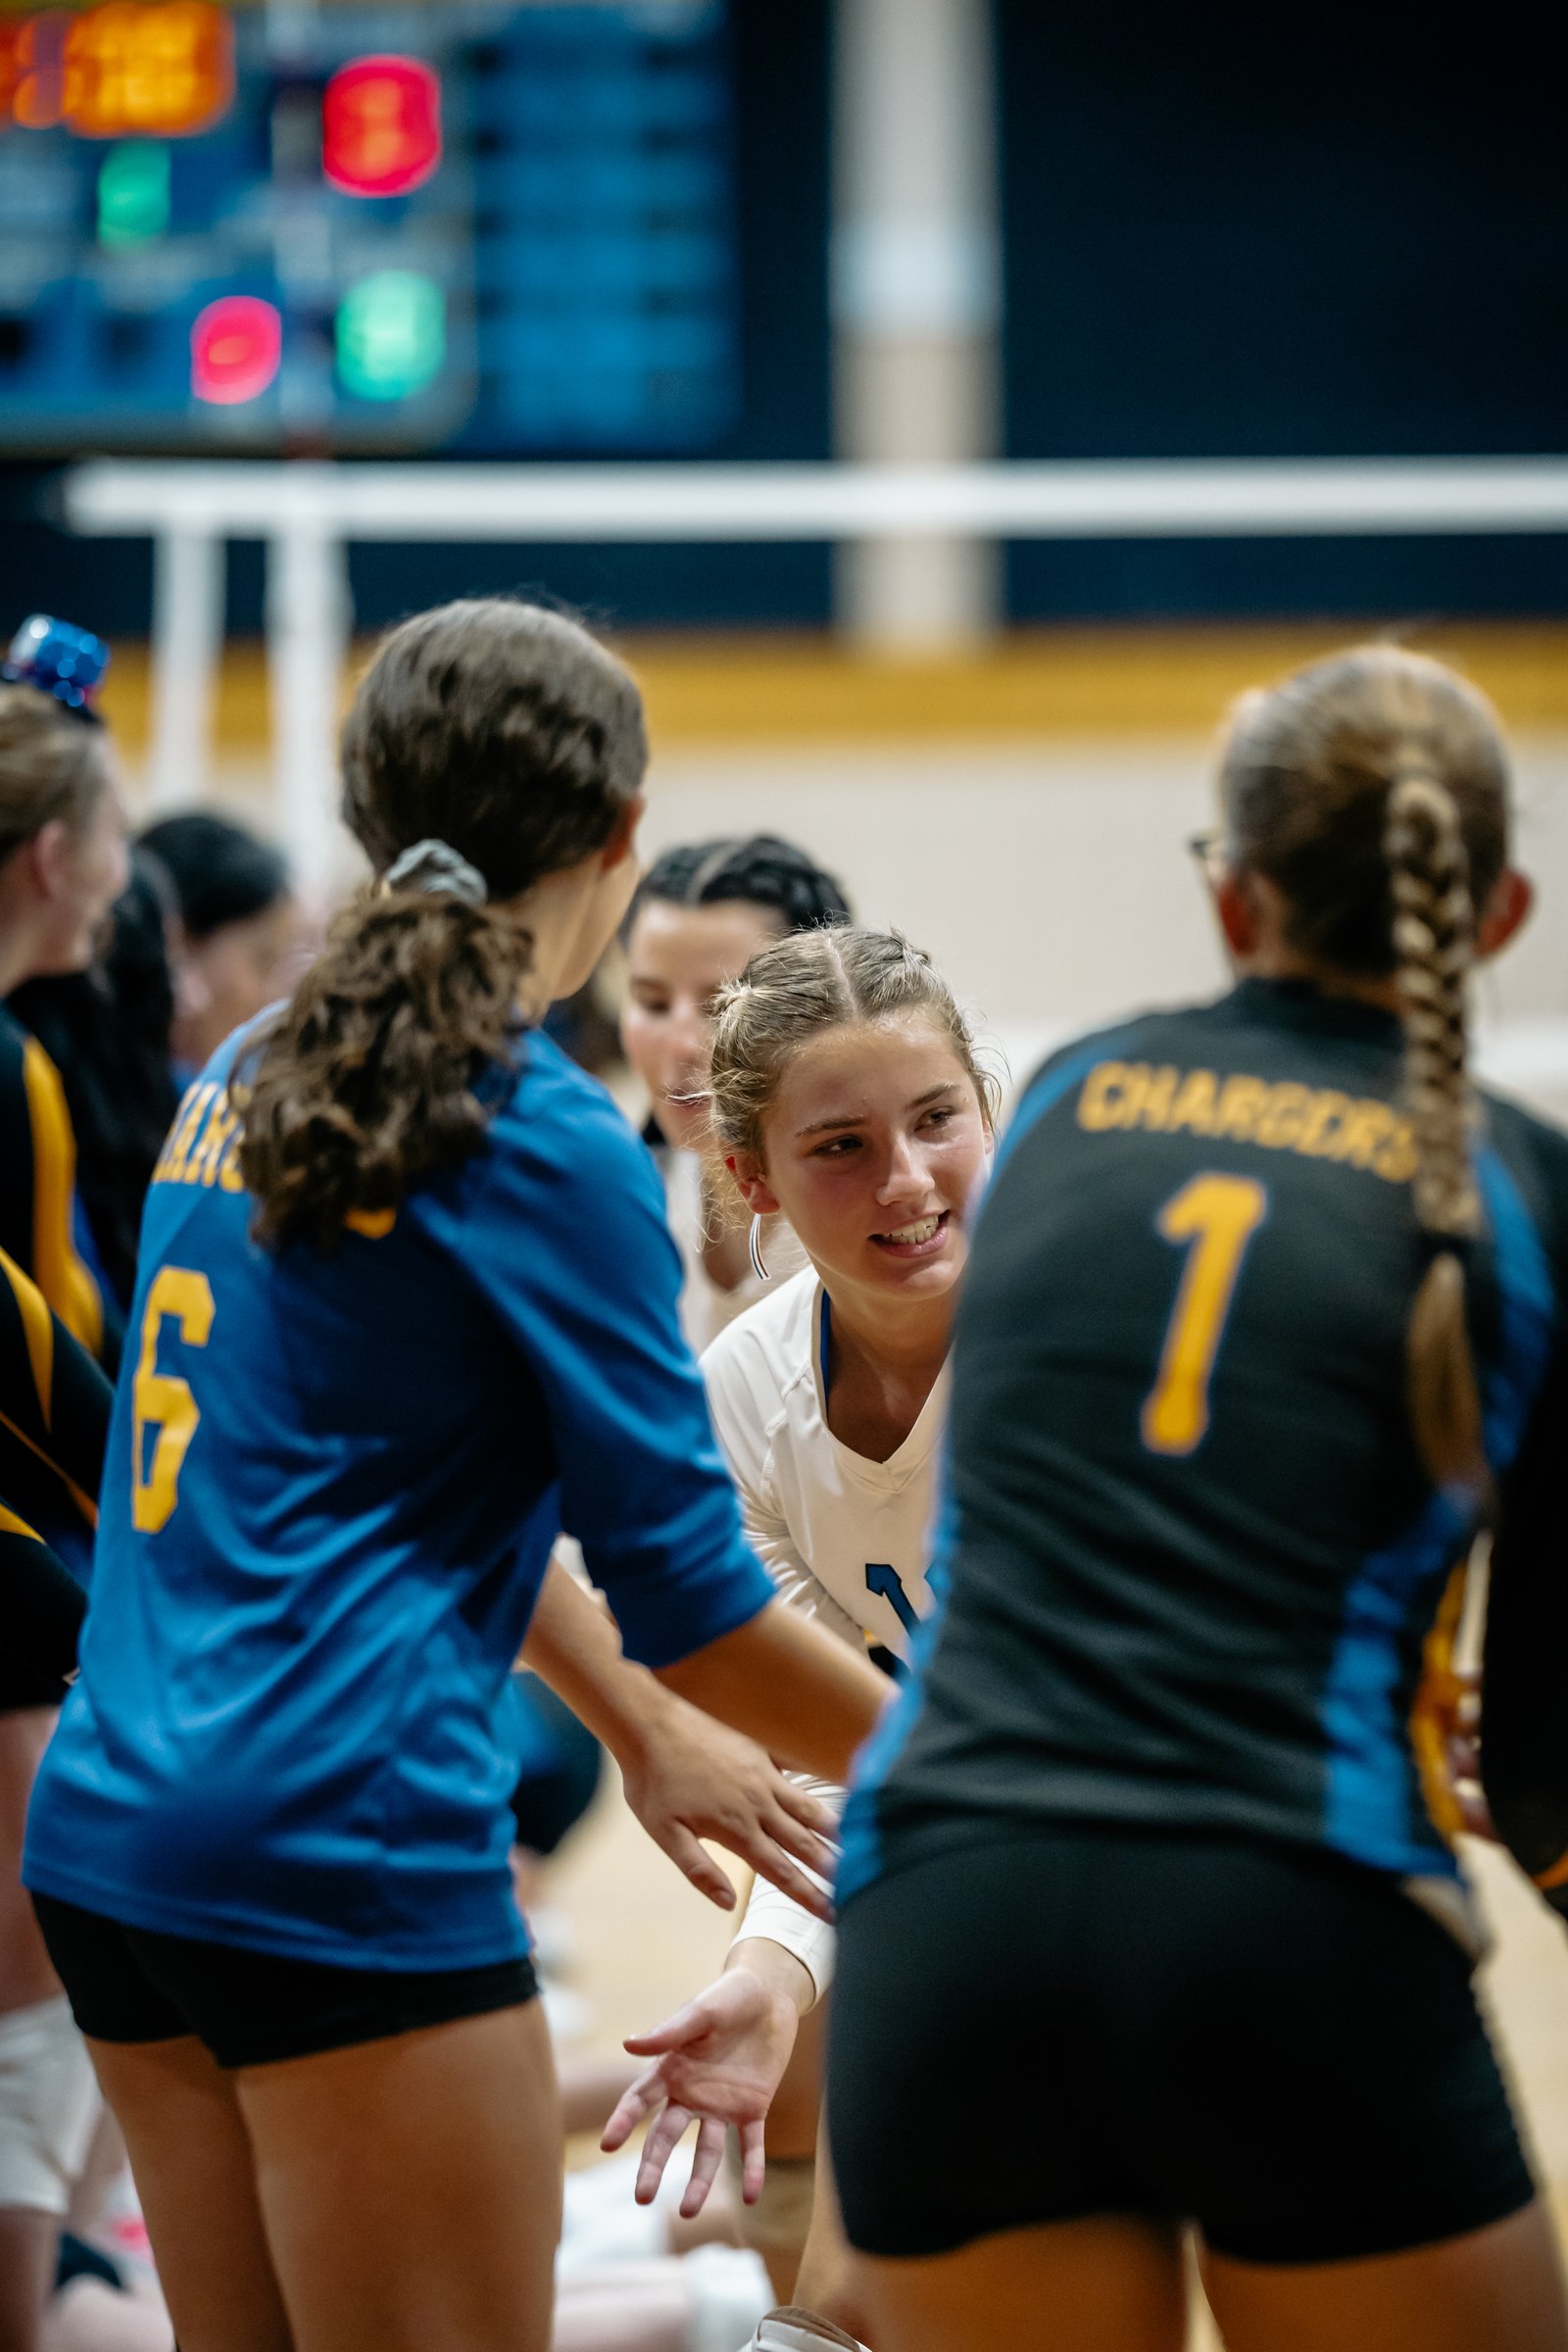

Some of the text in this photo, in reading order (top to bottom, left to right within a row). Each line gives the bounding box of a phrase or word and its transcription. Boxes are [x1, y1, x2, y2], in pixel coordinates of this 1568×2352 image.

[132, 1265, 216, 1534] 6
[1143, 1173, 1265, 1455] 1
[864, 1563, 937, 1642] 1
